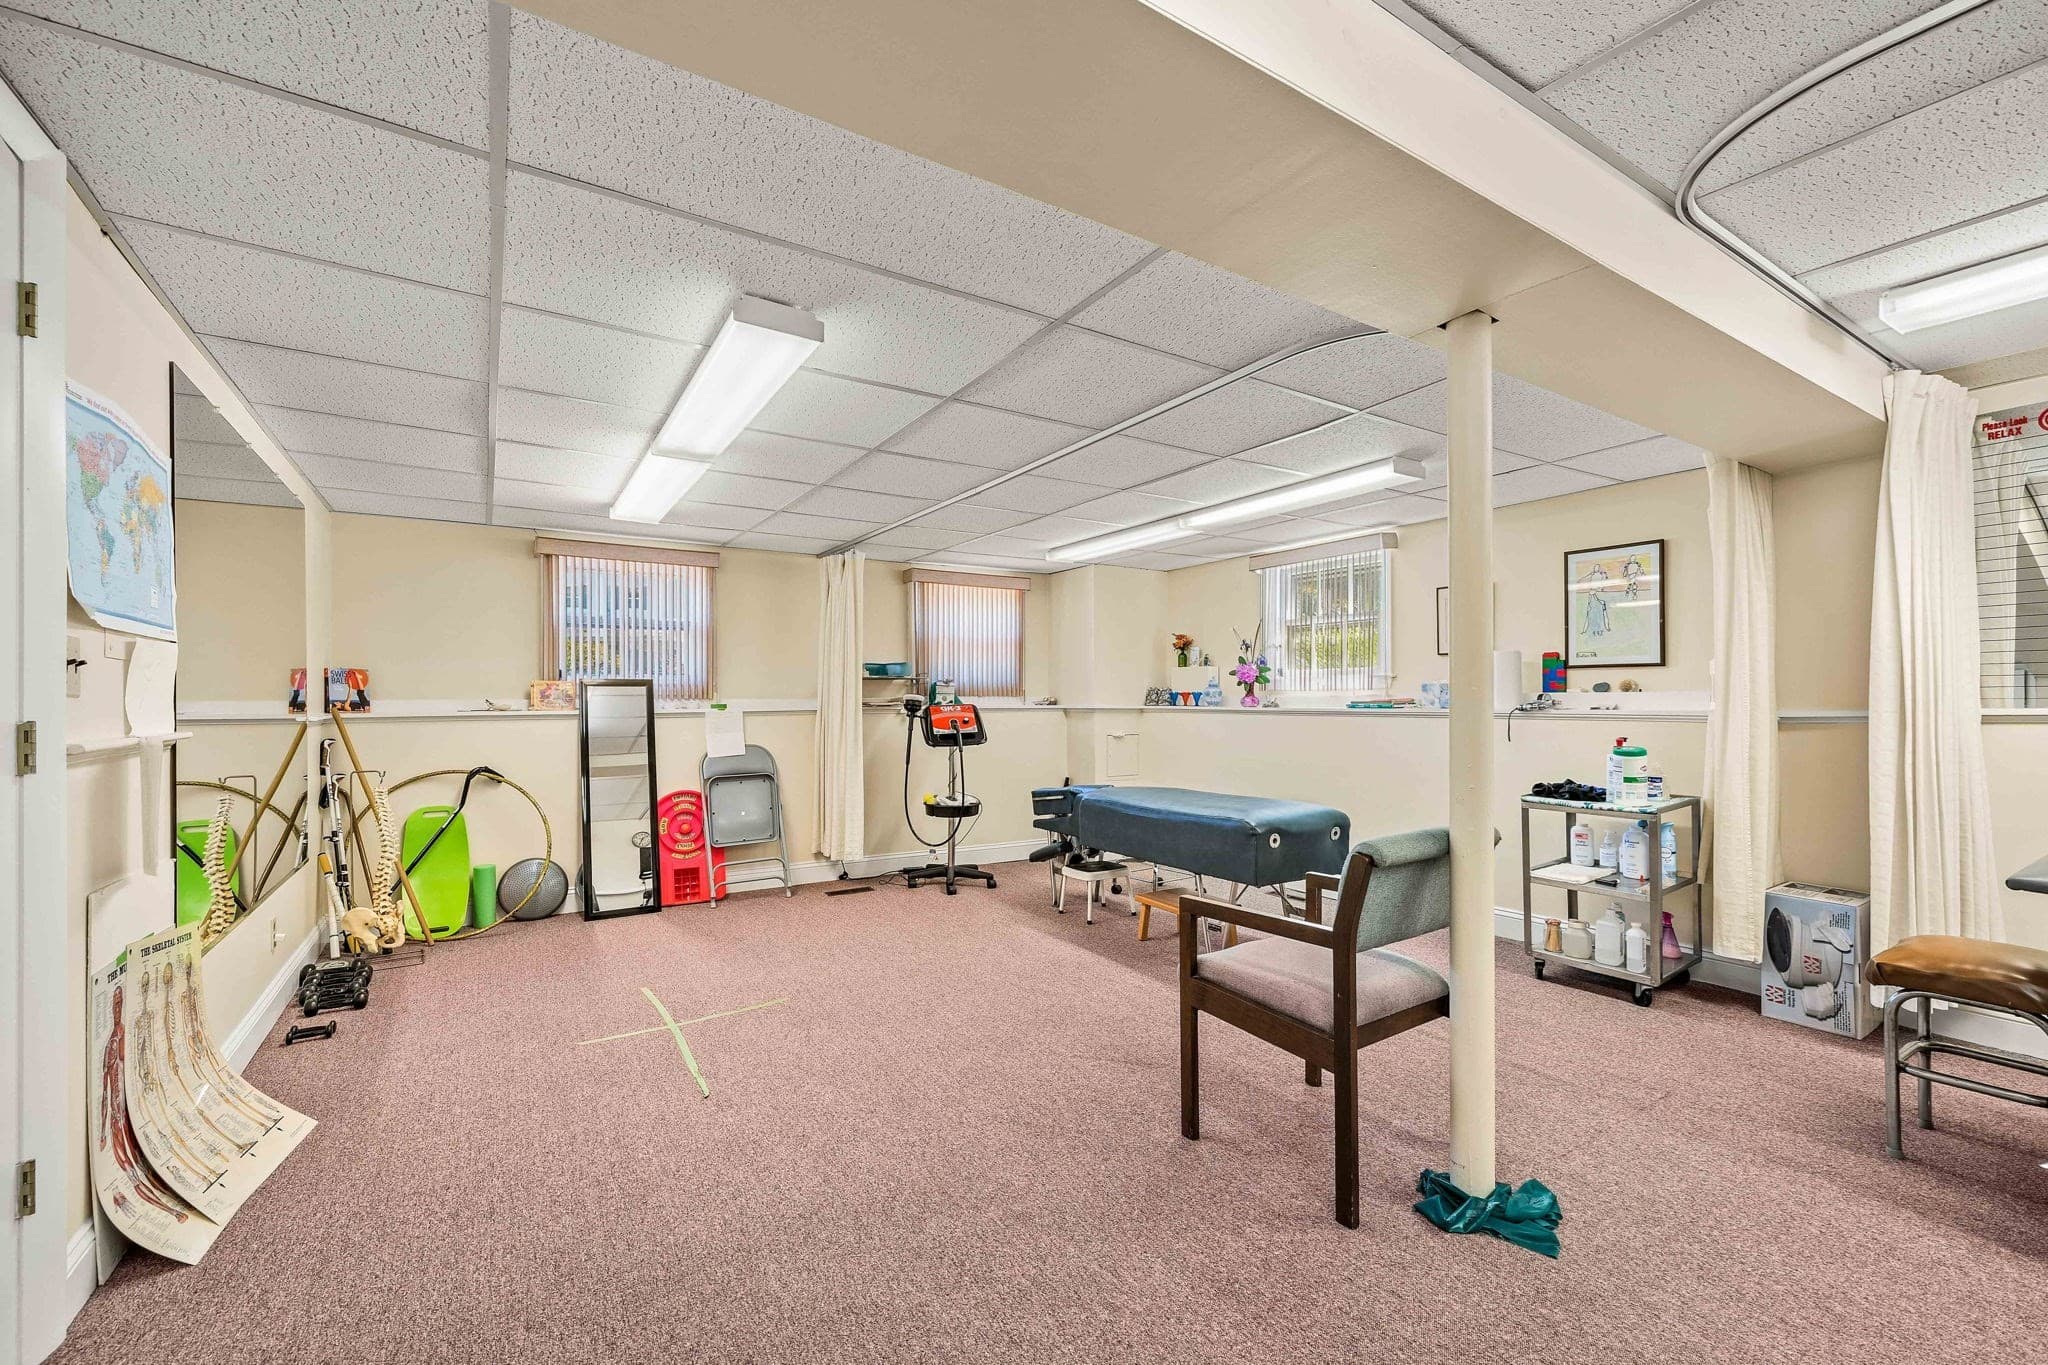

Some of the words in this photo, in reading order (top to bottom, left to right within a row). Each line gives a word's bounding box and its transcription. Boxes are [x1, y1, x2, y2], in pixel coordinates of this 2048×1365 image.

[1982, 421, 2007, 431] Please
[1988, 427, 2022, 440] RELAX
[330, 670, 352, 678] SWISS
[140, 947, 151, 958] THE
[152, 938, 176, 954] SKELETAL
[176, 932, 192, 945] SYSTEM
[107, 970, 119, 983] THE
